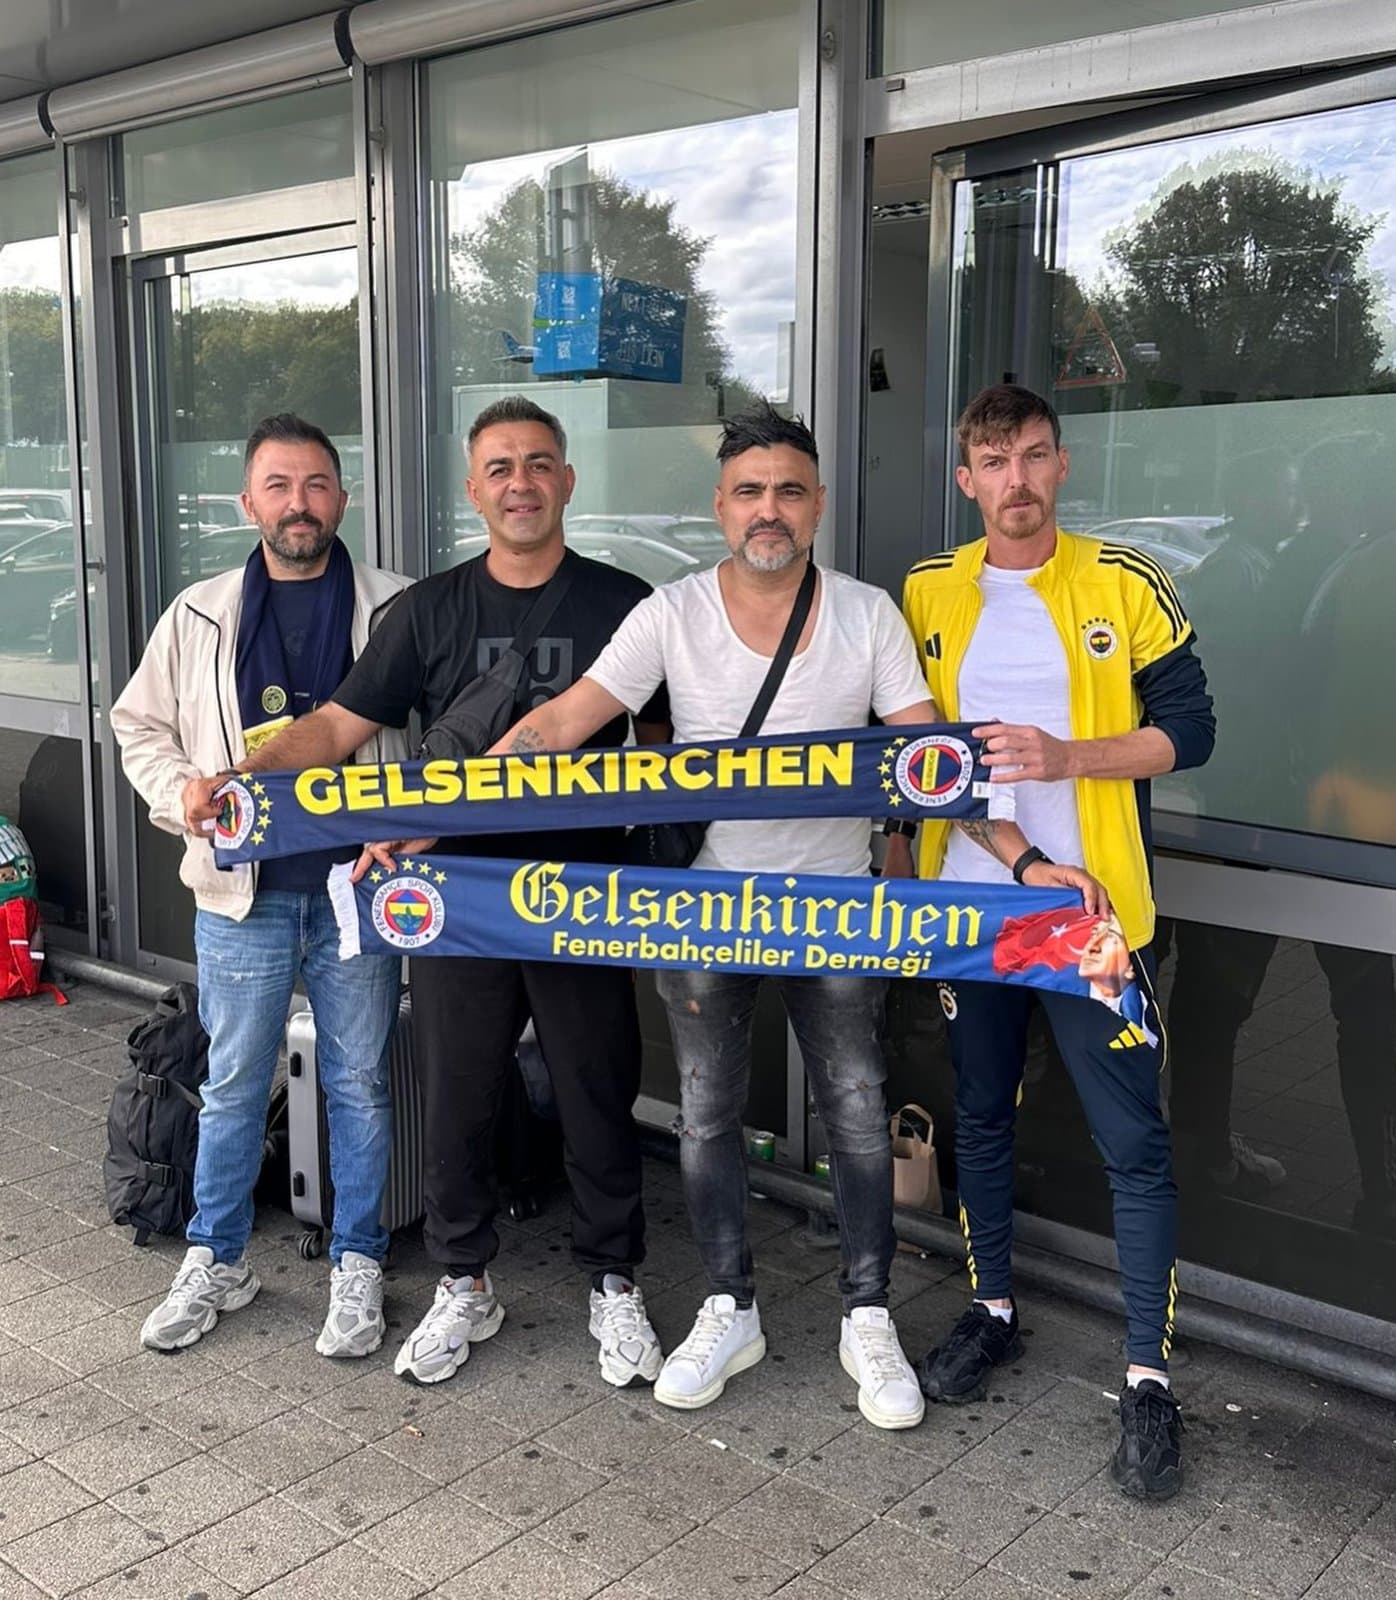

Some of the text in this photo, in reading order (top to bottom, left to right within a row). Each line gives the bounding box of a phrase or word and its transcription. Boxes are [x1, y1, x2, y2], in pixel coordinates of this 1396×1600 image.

[294, 742, 855, 815] GELSENKIRCHEN
[408, 879, 434, 897] SPOR
[509, 861, 985, 953] Gelsenkirchen
[398, 936, 421, 946] 1907
[552, 931, 933, 977] Fenerbahçeliler Derneği
